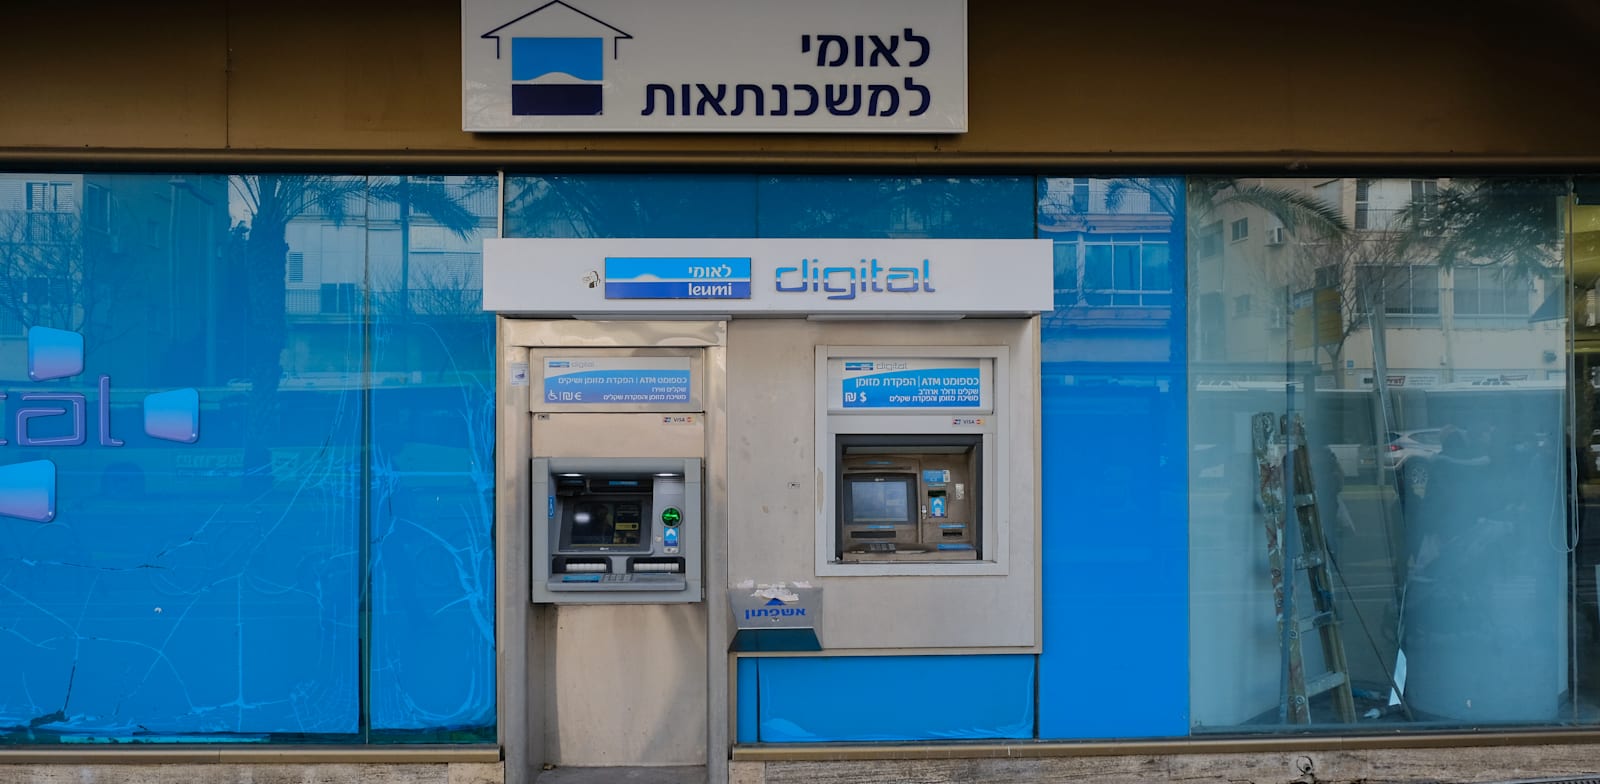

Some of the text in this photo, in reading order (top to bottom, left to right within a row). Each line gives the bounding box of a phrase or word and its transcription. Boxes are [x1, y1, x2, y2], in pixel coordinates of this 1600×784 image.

[801, 28, 931, 68] לאומי
[640, 77, 931, 118] למשכנתאות
[688, 264, 732, 278] לאומי
[775, 258, 936, 301] digital
[688, 283, 732, 296] leumi
[856, 378, 979, 388] כספומט ATM הפקדת מזומן
[889, 395, 910, 403] שקלים
[0, 374, 124, 446] al
[744, 608, 806, 620] אשפתון
